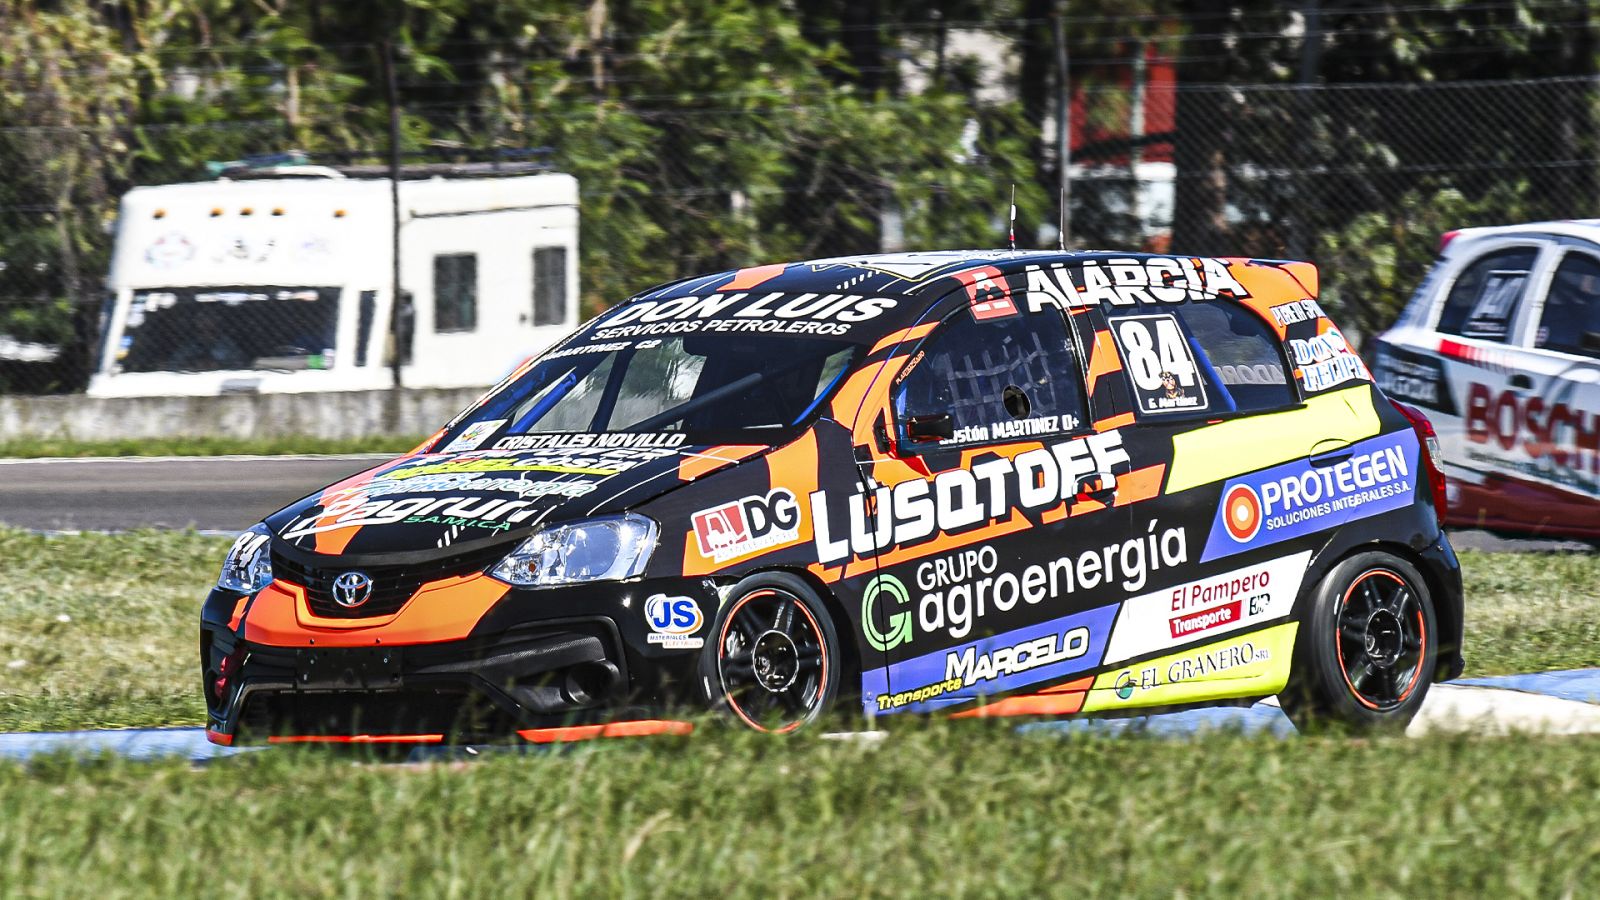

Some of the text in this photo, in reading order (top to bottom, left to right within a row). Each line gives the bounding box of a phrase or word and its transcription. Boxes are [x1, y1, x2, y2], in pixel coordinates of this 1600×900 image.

[1025, 258, 1246, 313] ALARCIA
[590, 319, 852, 341] SERVICIOS PETROLEROS
[597, 293, 898, 328] DON LUIS
[1119, 319, 1196, 391] 84
[1290, 335, 1335, 363] DON
[492, 435, 598, 450] CRISTALES
[592, 433, 687, 448] NOVILLO
[992, 415, 1060, 440] MARTINEZ
[1466, 381, 1600, 465] BOSCH
[512, 457, 637, 472] COSTA
[1260, 445, 1409, 516] PROTEGEN
[1266, 502, 1332, 531] SOLUCIONES
[1333, 485, 1395, 512] INTEGRALES
[917, 545, 998, 591] GRUPO
[918, 519, 1188, 638] agroenergía
[1171, 571, 1270, 612] El Pampero
[653, 601, 696, 628] JS
[1173, 608, 1231, 634] Transporte
[946, 634, 1089, 686] MARCELO
[1141, 668, 1162, 690] EL
[1168, 643, 1254, 683] GRANERO
[877, 678, 963, 709] Transporte
